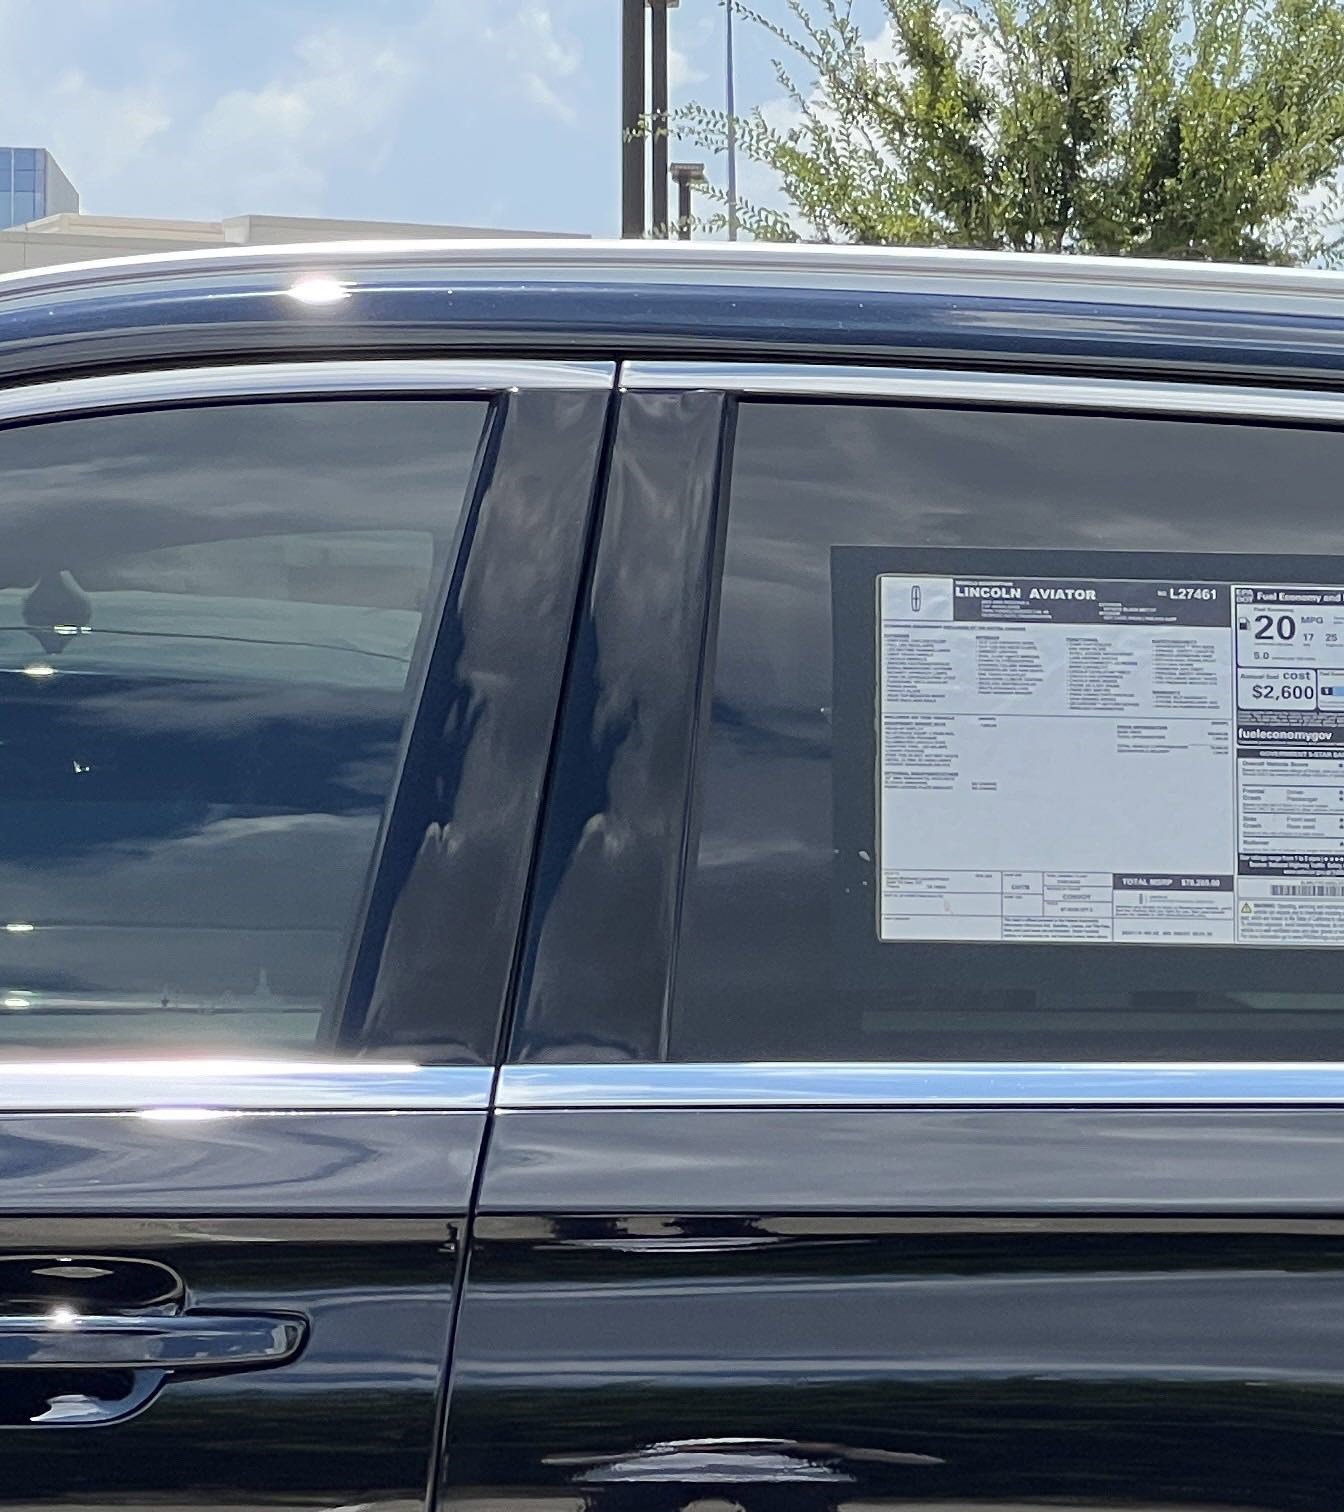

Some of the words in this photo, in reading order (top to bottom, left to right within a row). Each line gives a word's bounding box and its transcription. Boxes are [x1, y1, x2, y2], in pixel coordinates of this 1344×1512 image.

[955, 587, 1021, 599] LINCOLN
[1029, 588, 1097, 600] AVIATOR
[1170, 588, 1217, 600] L27461
[1254, 615, 1296, 640] 20
[1303, 633, 1314, 641] 17
[1325, 633, 1338, 642] 25
[1283, 671, 1311, 681] cost
[1252, 684, 1314, 701] $2,600
